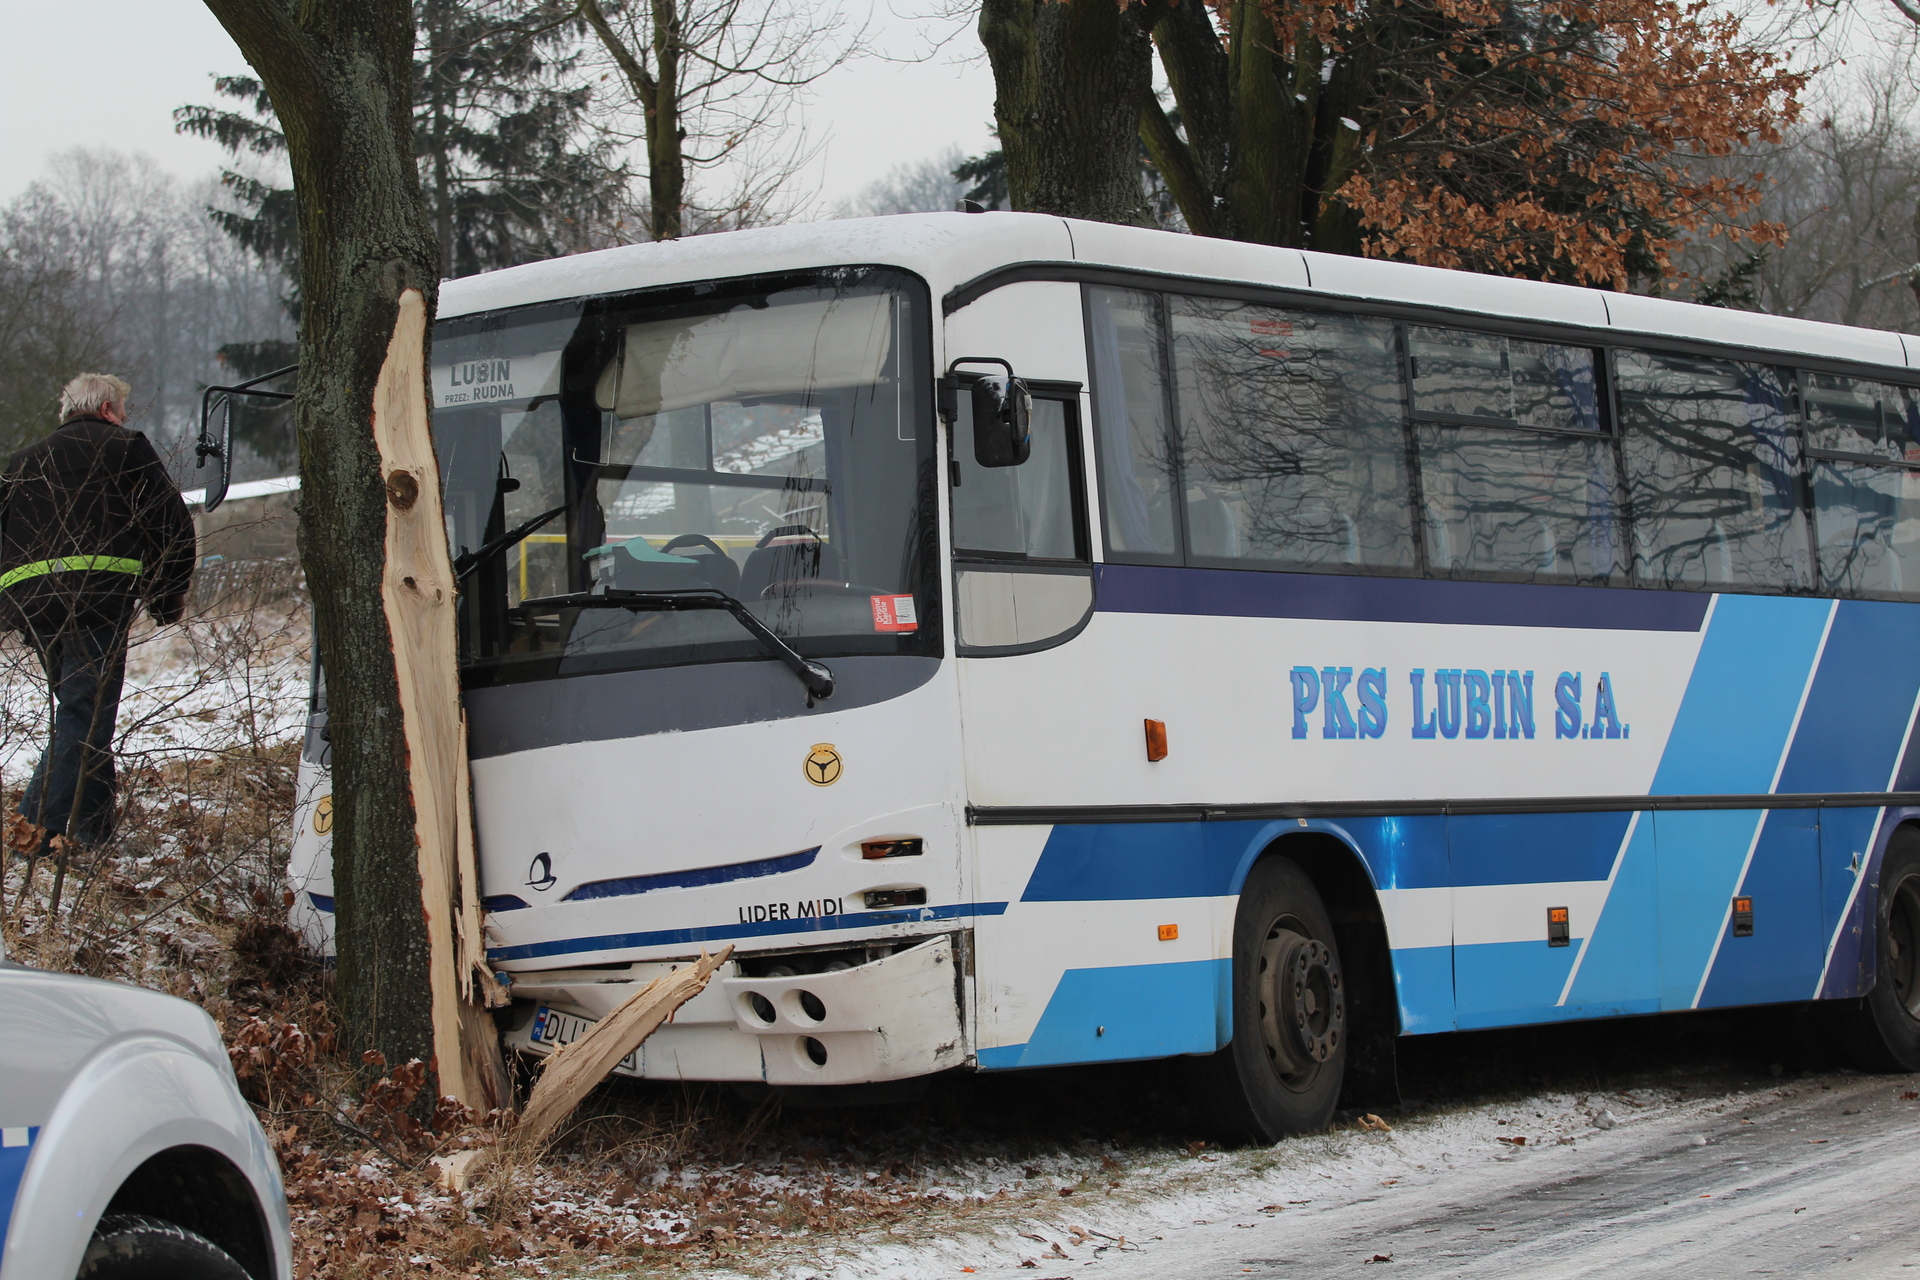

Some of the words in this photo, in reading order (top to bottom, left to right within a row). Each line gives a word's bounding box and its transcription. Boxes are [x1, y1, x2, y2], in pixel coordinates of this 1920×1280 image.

[451, 360, 510, 386] LUBIN
[445, 393, 470, 403] PRZEZ:
[474, 383, 516, 400] RUDNĄ
[1290, 666, 1388, 739] PKS
[1409, 668, 1536, 740] LUBIN
[1554, 671, 1630, 740] S.A.
[739, 903, 790, 924] LIDER
[798, 898, 843, 919] MIDI
